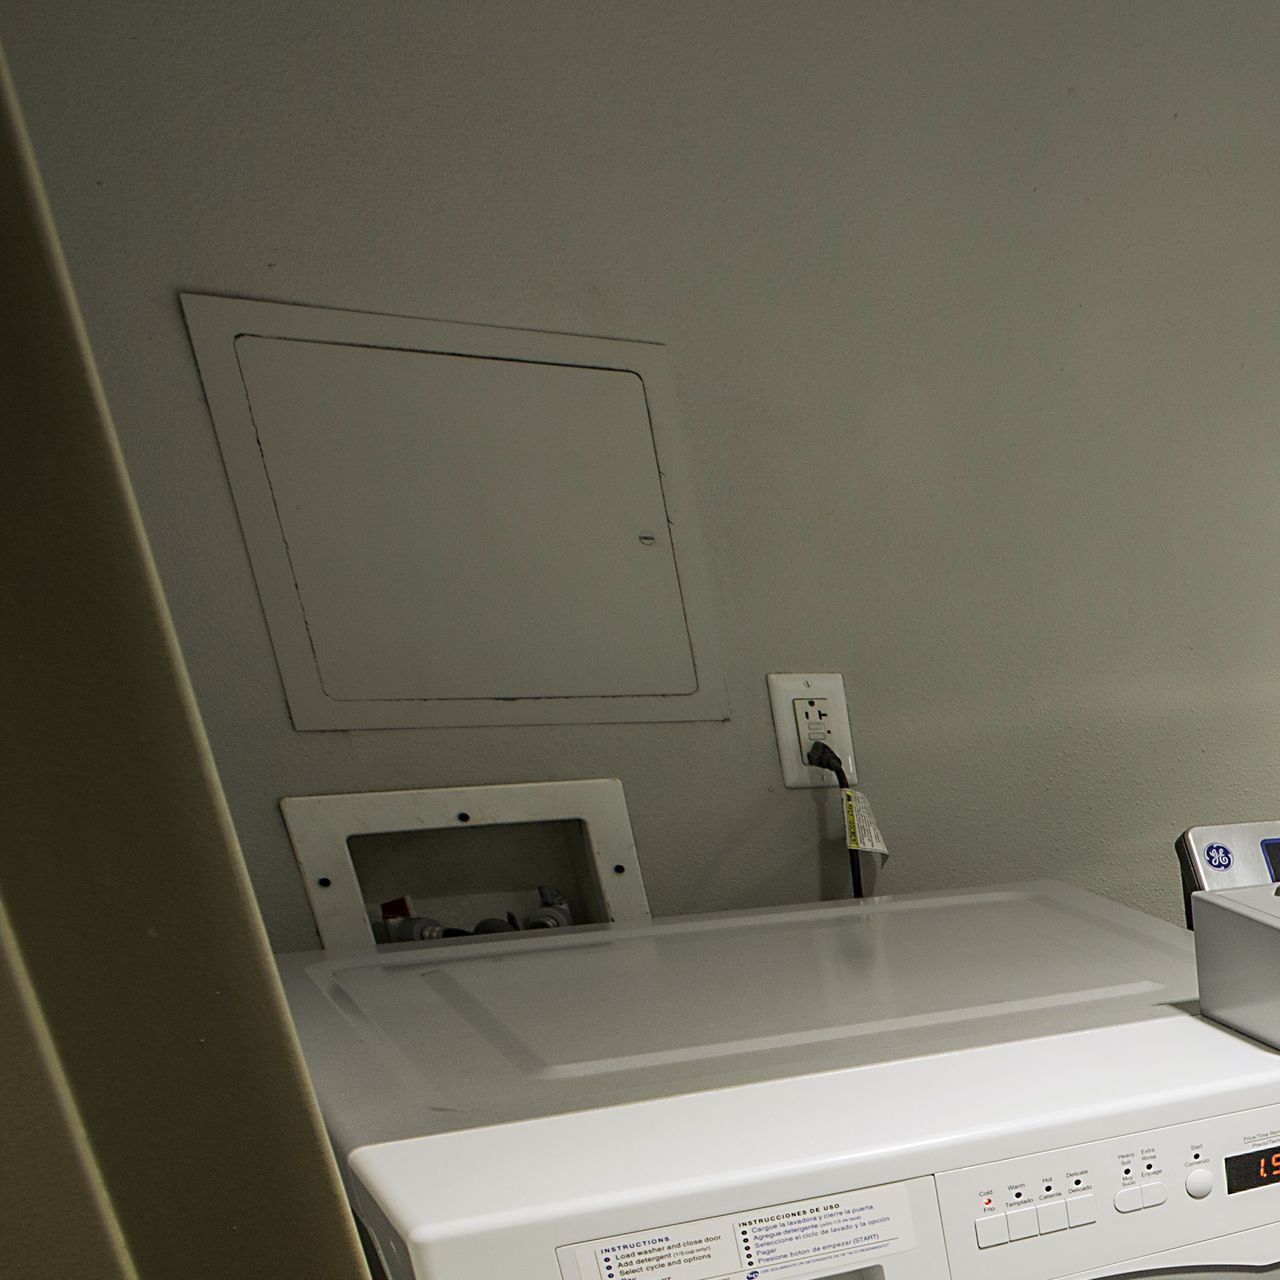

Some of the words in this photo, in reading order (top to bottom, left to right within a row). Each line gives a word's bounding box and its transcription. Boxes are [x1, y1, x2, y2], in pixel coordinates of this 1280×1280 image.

[979, 1190, 993, 1198] Cold
[738, 1210, 807, 1228] INSTRUCCIONES
[824, 1203, 840, 1211] USO
[751, 1224, 778, 1234] Cargue
[787, 1216, 817, 1226] lavadora
[852, 1204, 874, 1214] puerta
[754, 1232, 782, 1240] Agregue
[783, 1224, 818, 1235] detergente
[754, 1237, 794, 1248] Seleccione
[830, 1224, 853, 1232] lavado
[600, 1236, 670, 1254] INSTRUCTIONS
[615, 1252, 636, 1260] Load
[637, 1246, 665, 1256] washer
[666, 1242, 681, 1250] and
[682, 1239, 703, 1248] close
[704, 1234, 722, 1244] door
[758, 1253, 788, 1264] Presione
[822, 1240, 852, 1250] empezar
[852, 1234, 880, 1245] (START)
[618, 1260, 634, 1268] Add
[636, 1253, 672, 1266] detergent
[619, 1267, 644, 1276] Select
[646, 1262, 666, 1272] cycle
[668, 1258, 682, 1266] and
[684, 1253, 712, 1264] options
